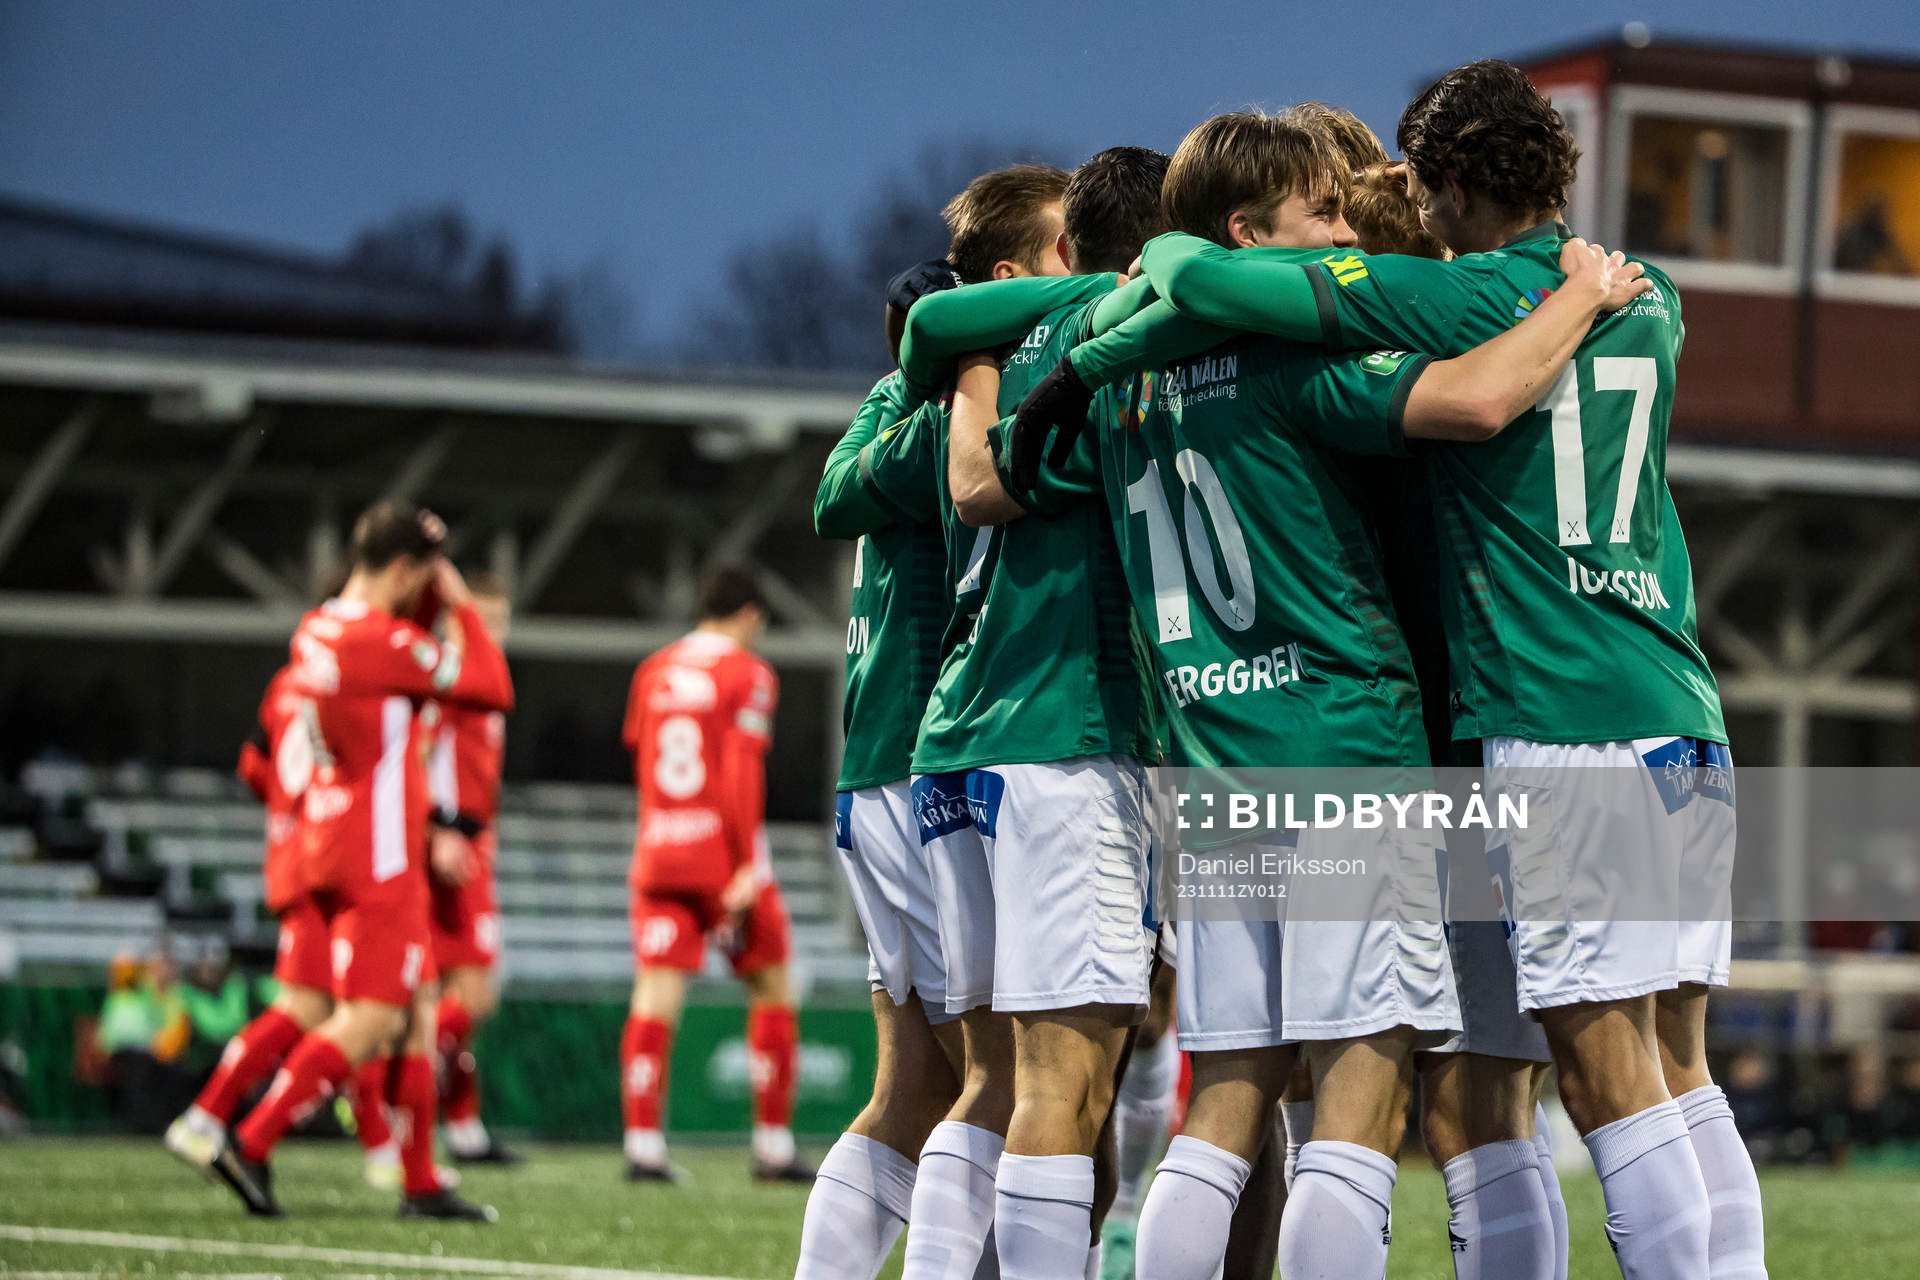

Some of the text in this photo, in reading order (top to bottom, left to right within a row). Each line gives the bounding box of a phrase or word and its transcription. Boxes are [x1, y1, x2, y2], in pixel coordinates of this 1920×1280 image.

[1536, 356, 1658, 547] 17
[1127, 448, 1256, 644] 10
[1163, 642, 1310, 709] ERGGREN
[653, 714, 707, 801] 8
